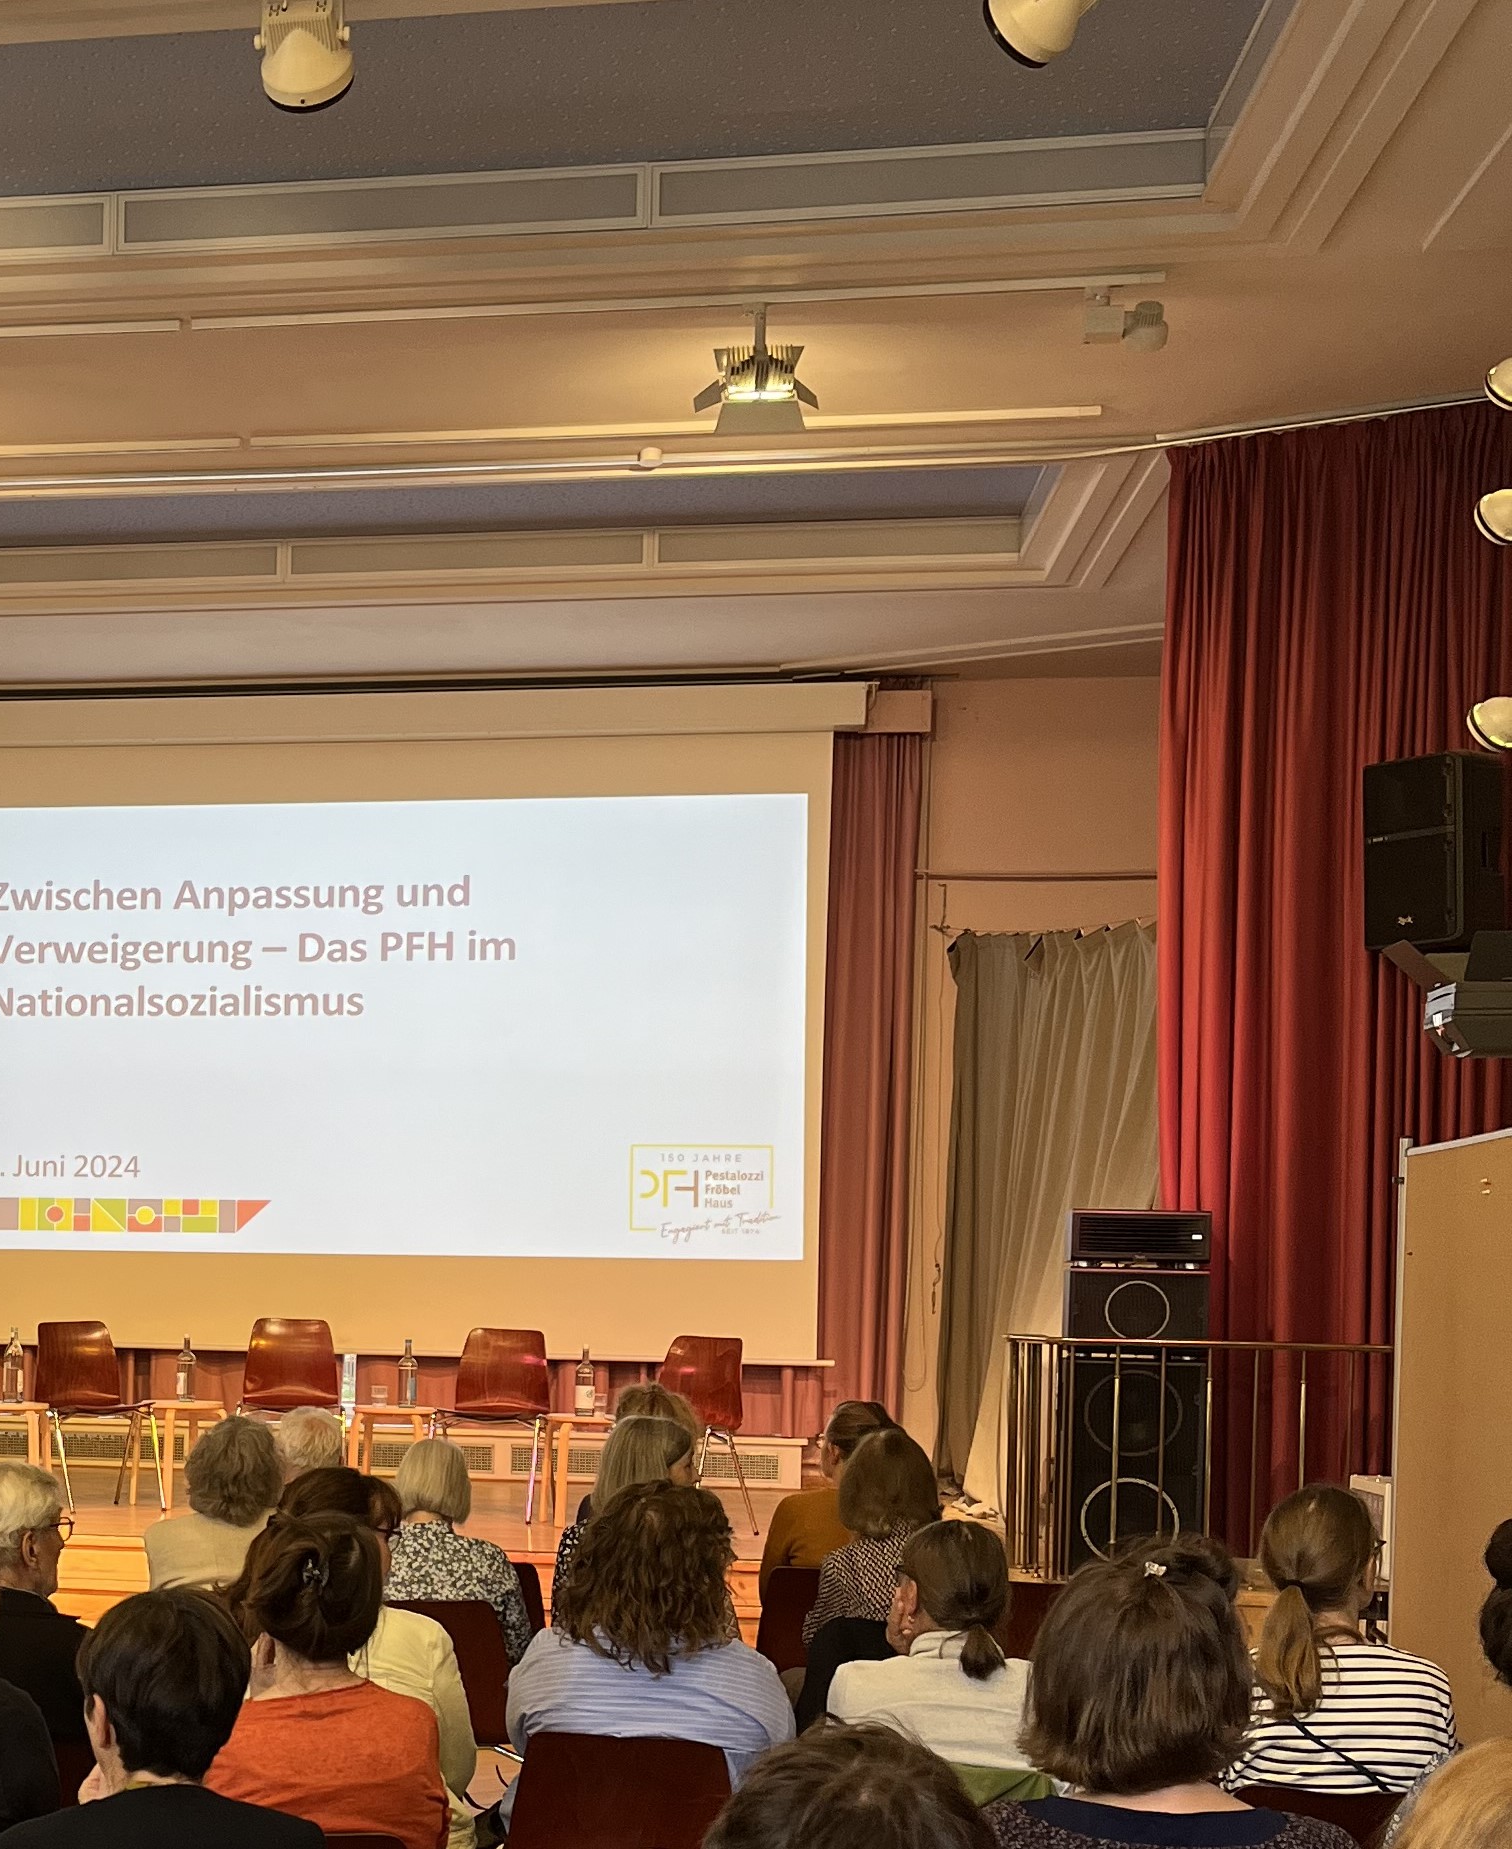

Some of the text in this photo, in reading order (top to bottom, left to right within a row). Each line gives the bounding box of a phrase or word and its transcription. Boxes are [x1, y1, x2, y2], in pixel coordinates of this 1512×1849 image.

[173, 878, 384, 917] Anpassung
[395, 875, 471, 908] und
[296, 932, 367, 963] Das
[379, 931, 455, 962] PFH
[467, 930, 517, 961] im
[12, 1154, 66, 1178] Juni
[73, 1154, 141, 1178] 2024
[660, 1153, 743, 1163] 150 JAHRE
[704, 1170, 764, 1182] Pestalozzi
[704, 1184, 741, 1196] Fröbel
[704, 1198, 734, 1209] Haus
[660, 1219, 712, 1244] Engagiert
